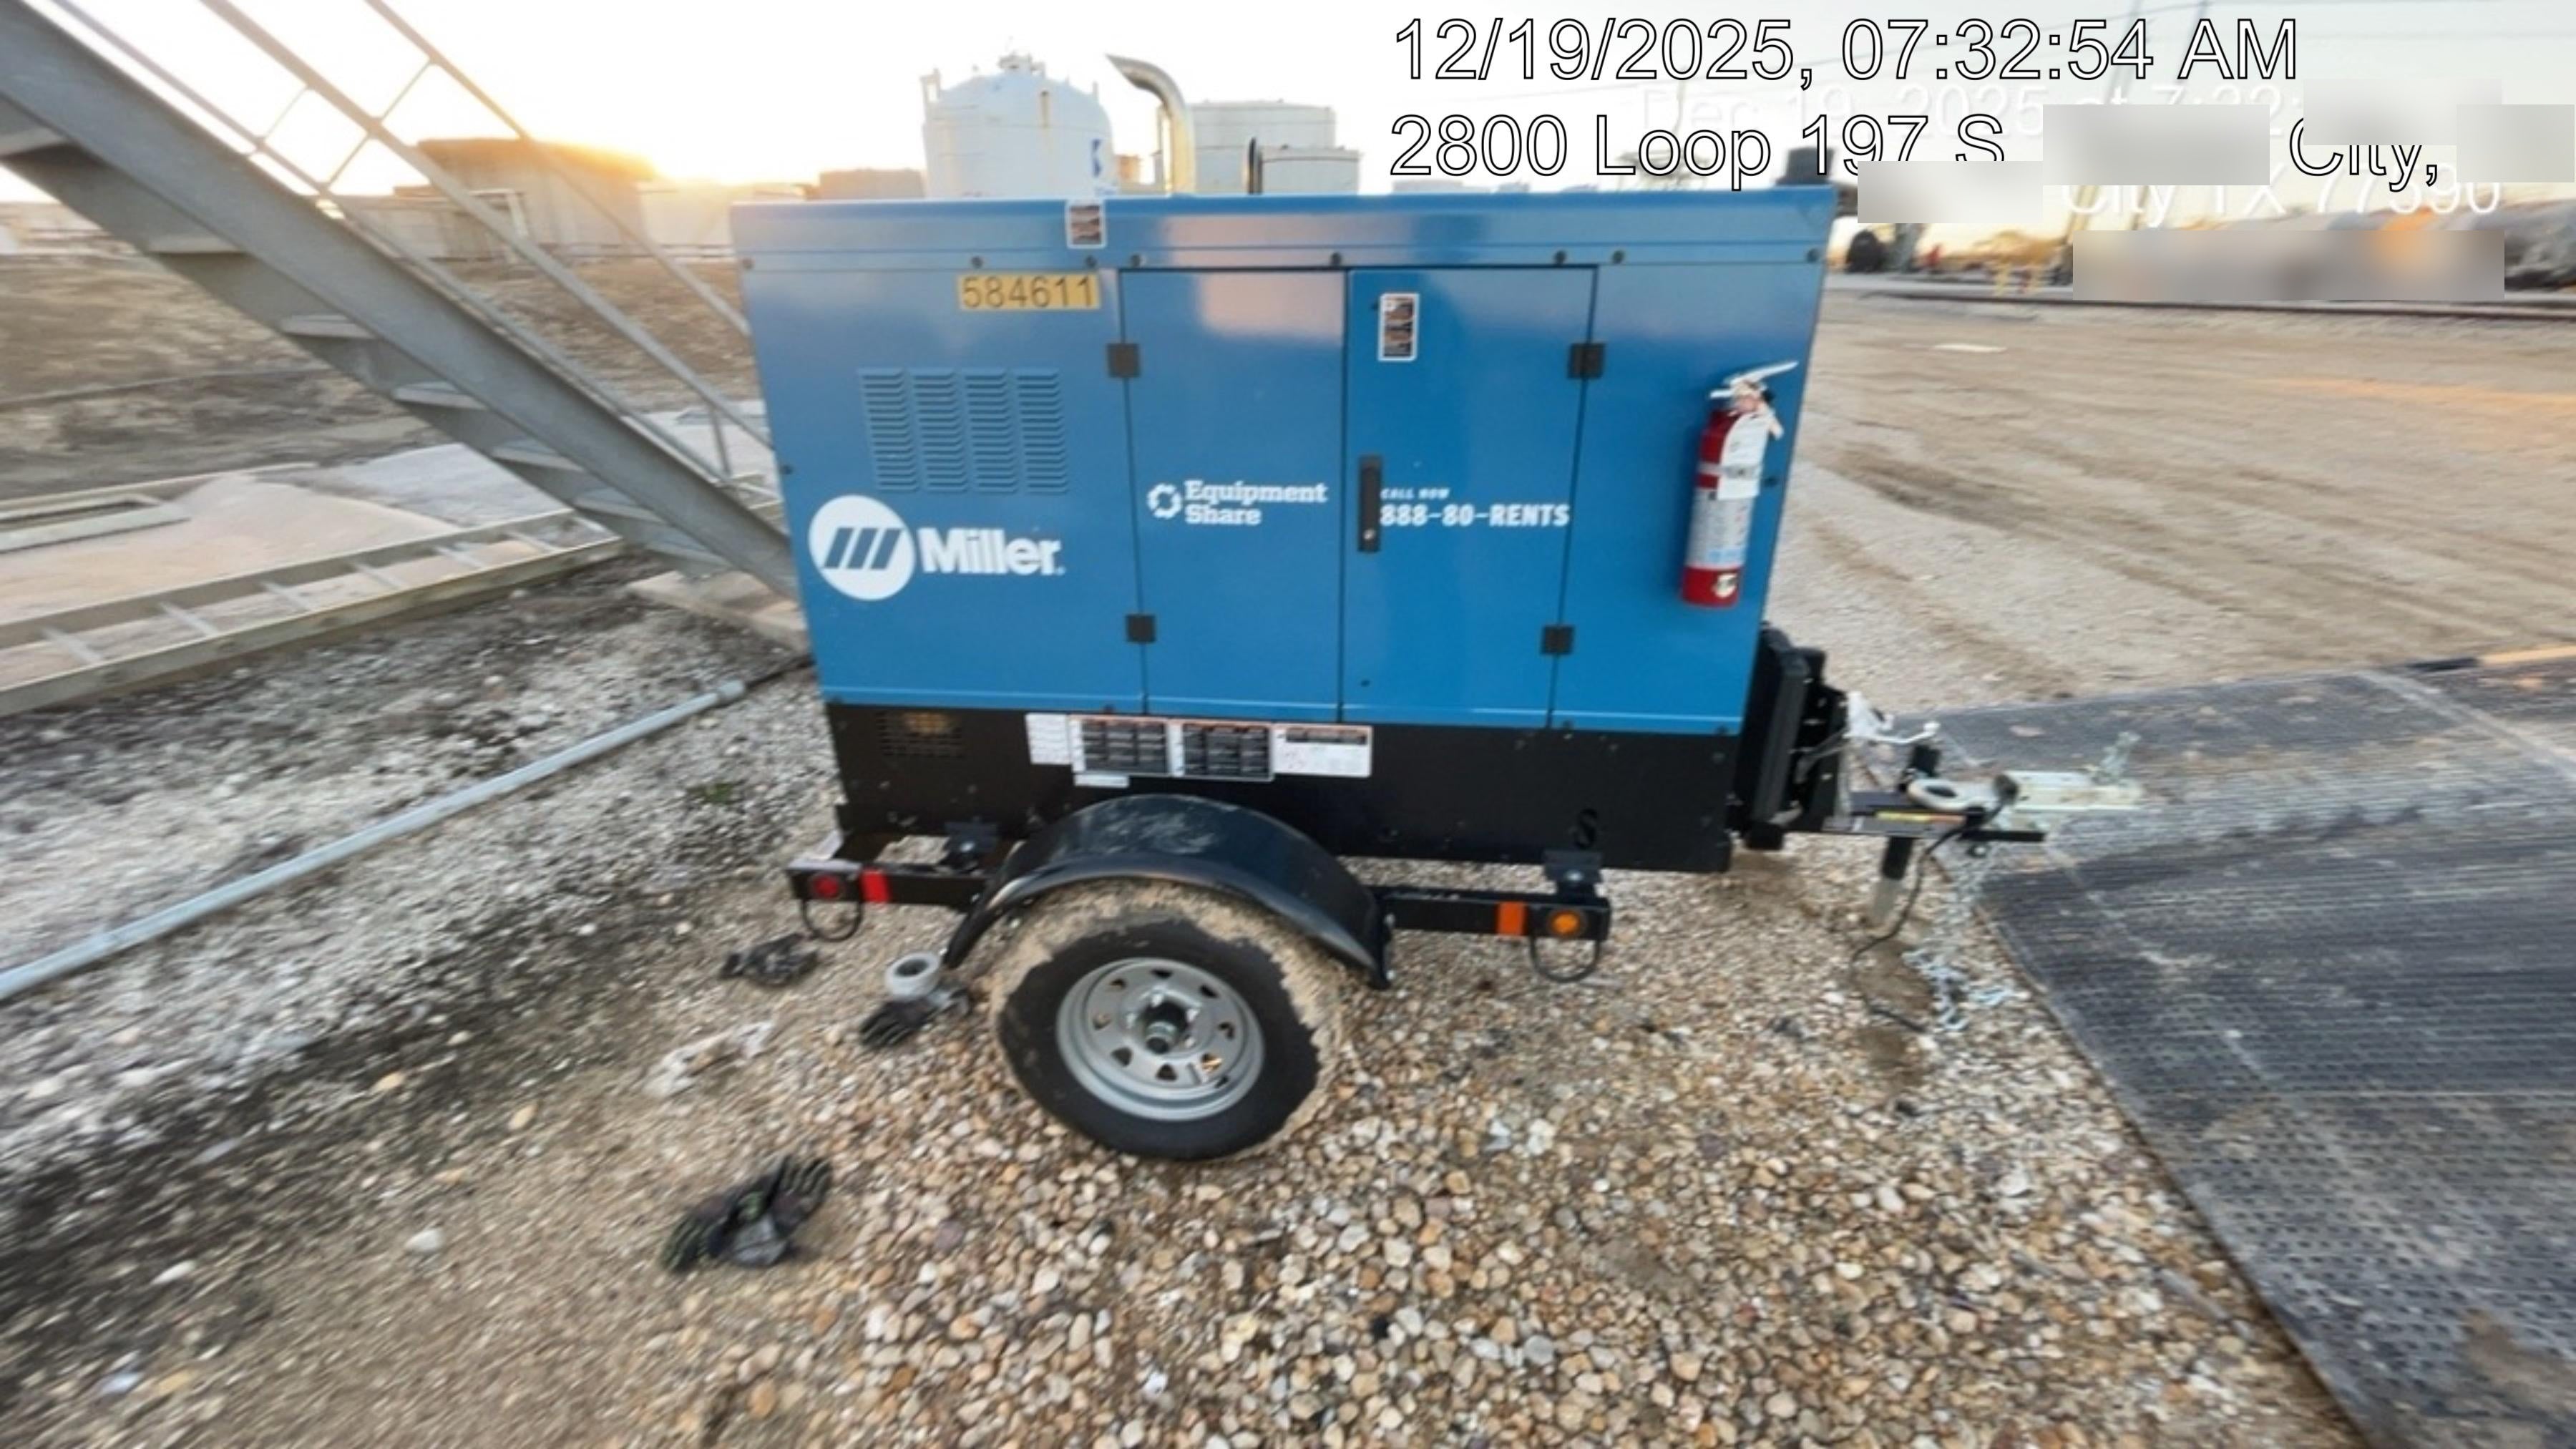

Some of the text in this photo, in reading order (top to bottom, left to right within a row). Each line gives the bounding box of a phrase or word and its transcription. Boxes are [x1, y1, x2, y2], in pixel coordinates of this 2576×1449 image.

[962, 275, 1092, 308] 584611
[1184, 479, 1329, 506] Equipment
[1380, 487, 1416, 500] CALL
[1184, 504, 1262, 526] Share
[1380, 503, 1571, 527] 888-80-RENTS
